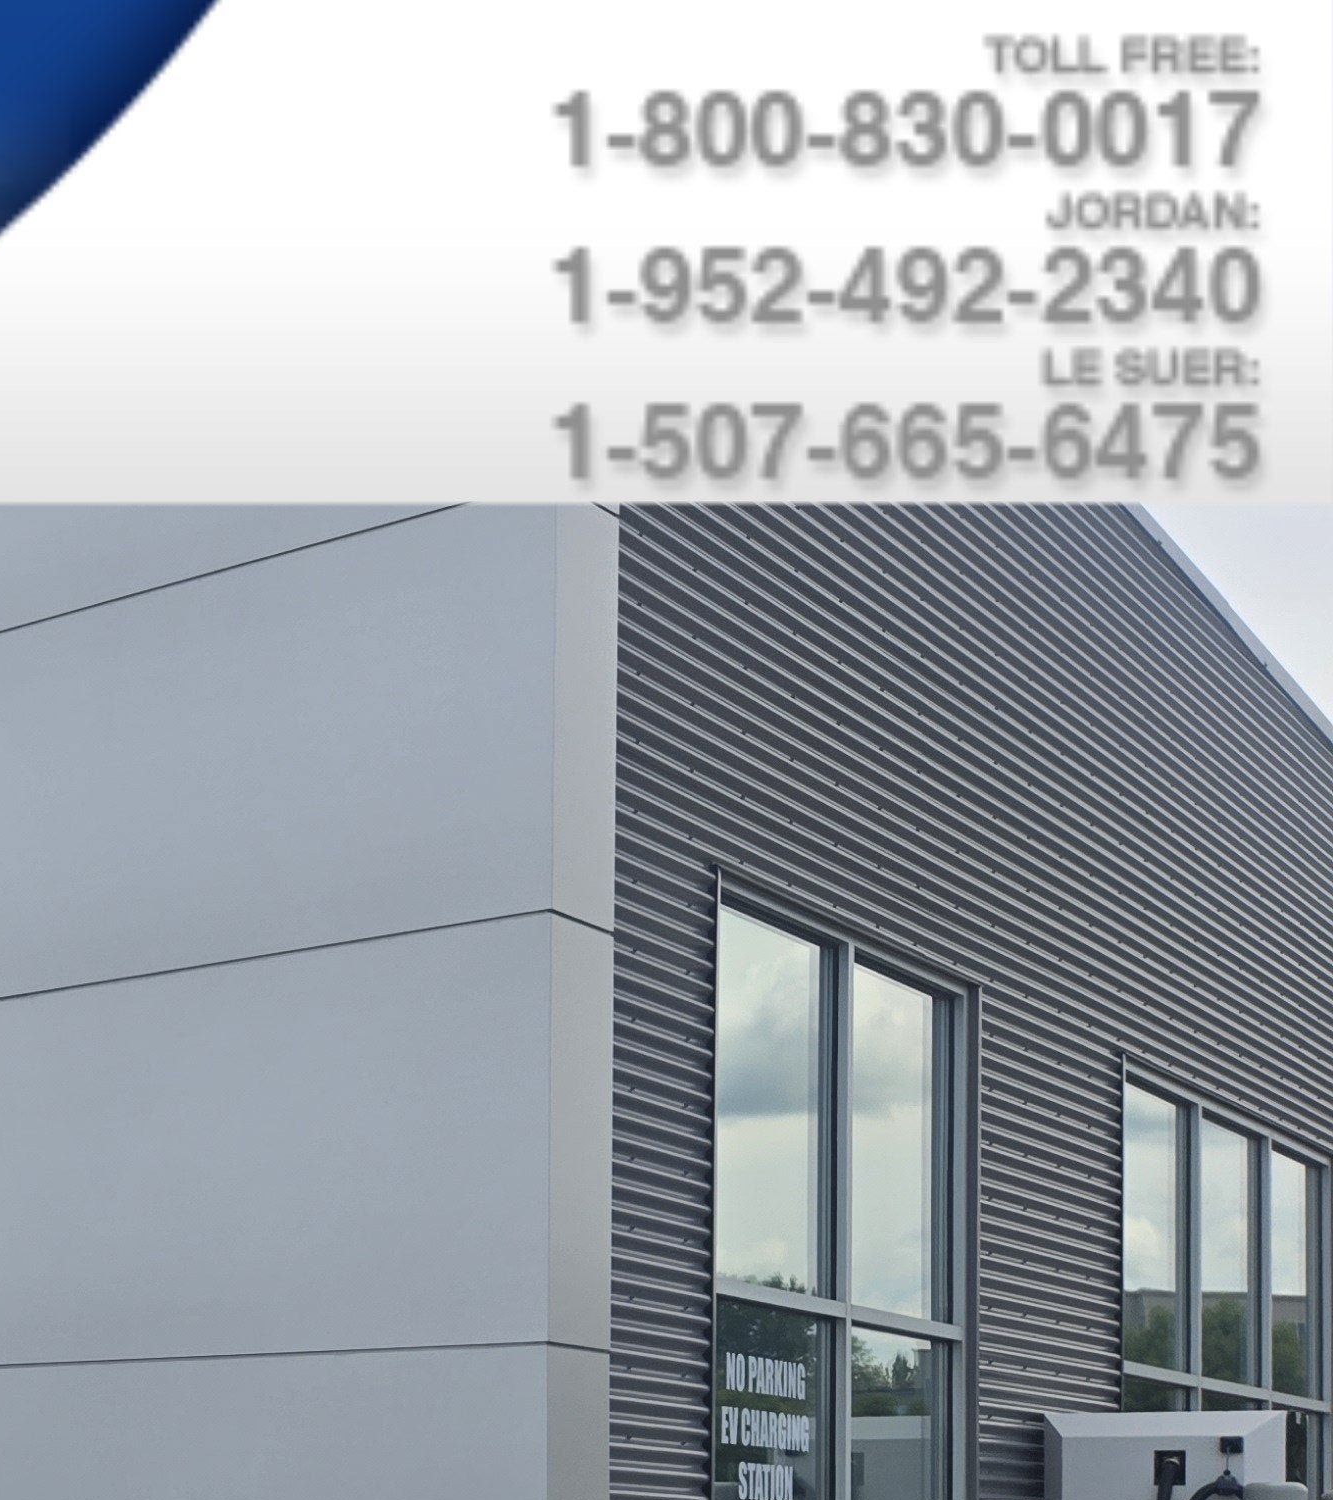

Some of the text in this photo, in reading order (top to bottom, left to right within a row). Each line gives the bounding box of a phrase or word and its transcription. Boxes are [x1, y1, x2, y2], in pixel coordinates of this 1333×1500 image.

[726, 1351, 806, 1400] NO PARKING
[721, 1405, 810, 1453] EV CHARGING
